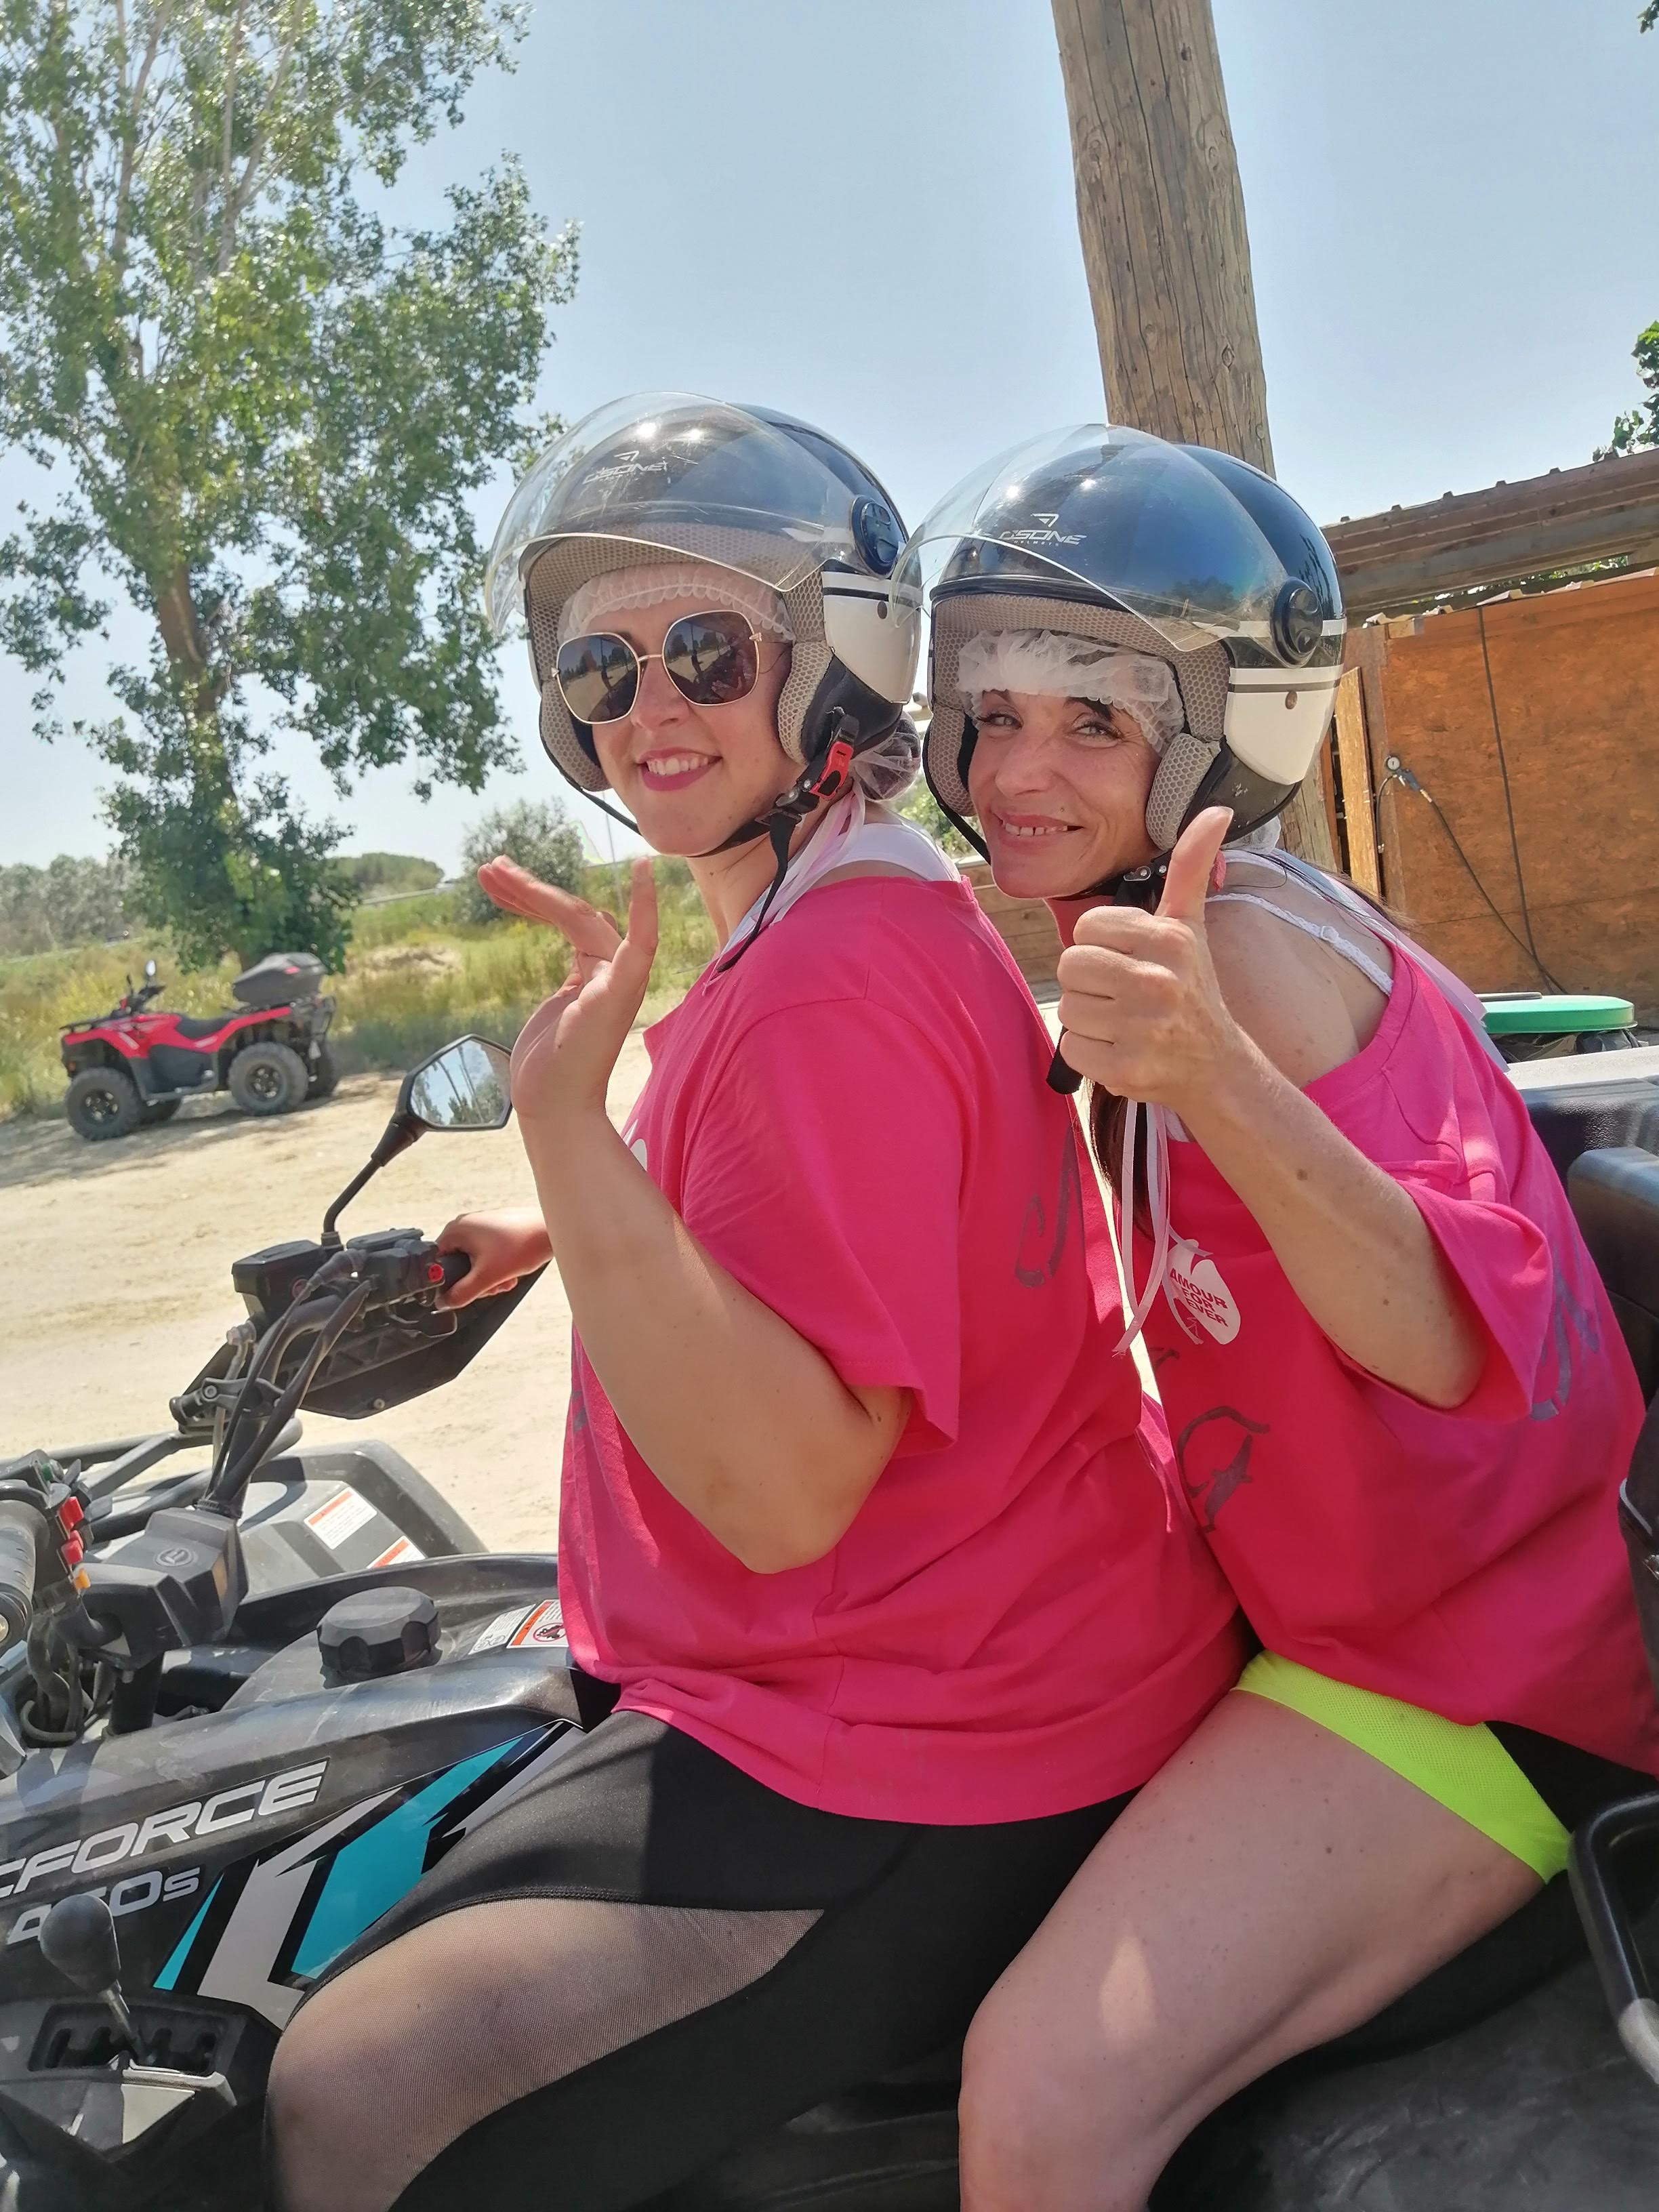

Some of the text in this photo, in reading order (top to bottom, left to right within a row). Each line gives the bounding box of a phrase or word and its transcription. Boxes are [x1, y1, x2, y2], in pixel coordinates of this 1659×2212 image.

[1170, 1267, 1228, 1309] AMOUR
[1181, 1287, 1215, 1312] FOR
[1185, 1297, 1229, 1327] EVER
